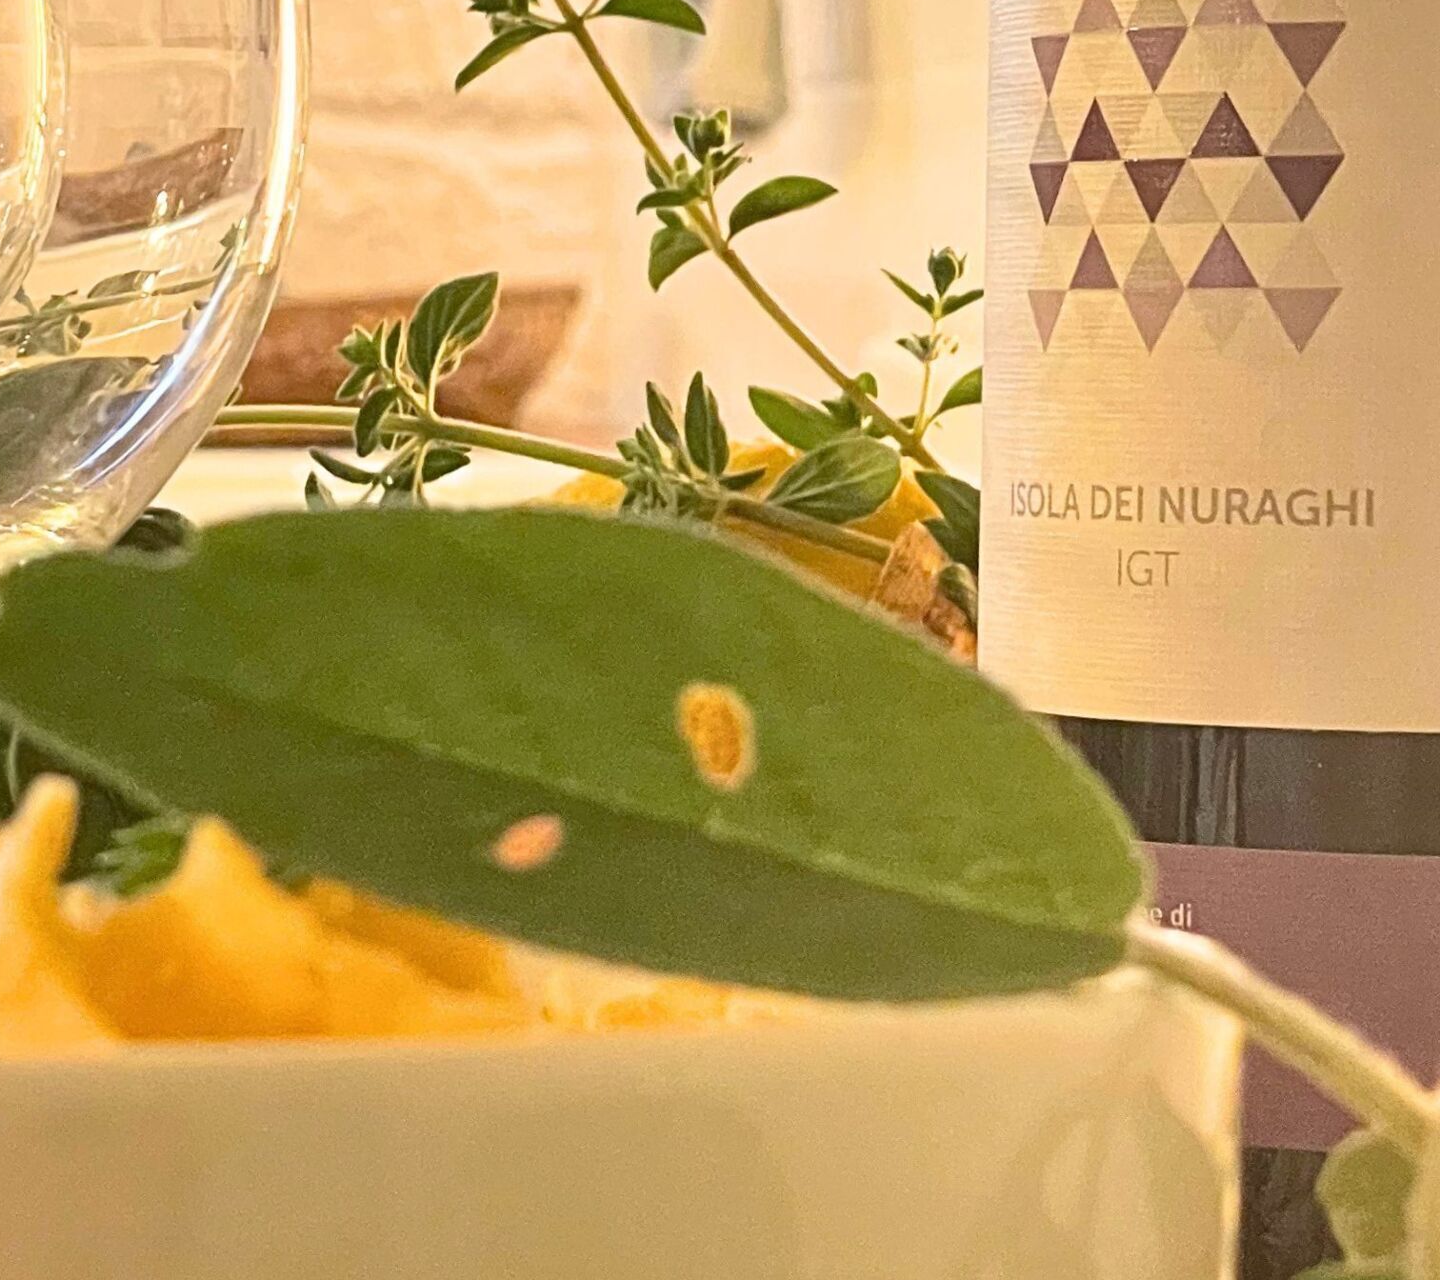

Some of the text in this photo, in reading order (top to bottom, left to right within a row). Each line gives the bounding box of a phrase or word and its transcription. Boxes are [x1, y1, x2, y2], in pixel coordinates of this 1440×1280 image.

[1010, 481, 1375, 528] ISOLA DEI NURAGHI
[1116, 548, 1180, 587] IGT
[1170, 903, 1192, 928] di
